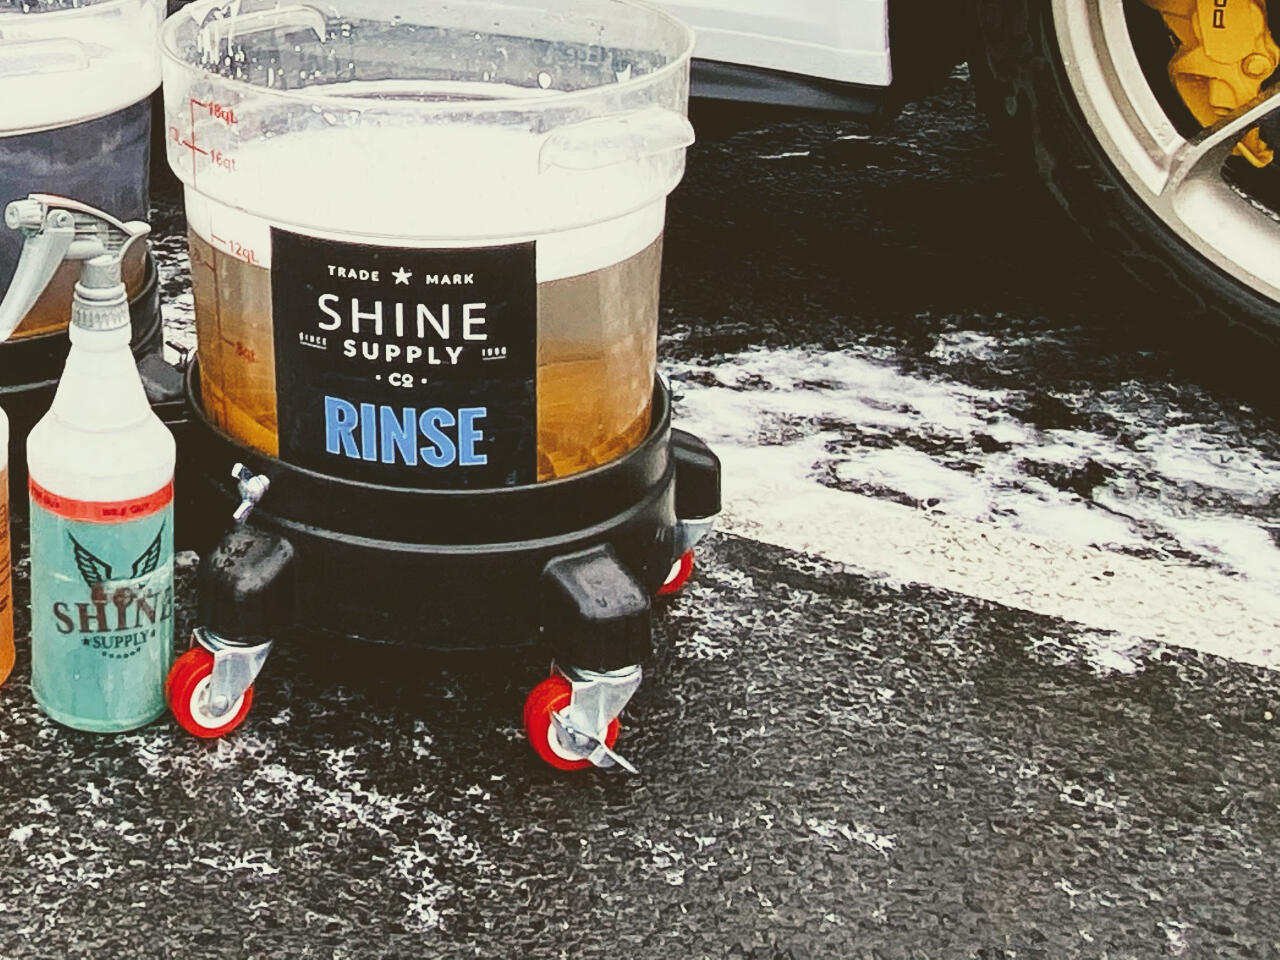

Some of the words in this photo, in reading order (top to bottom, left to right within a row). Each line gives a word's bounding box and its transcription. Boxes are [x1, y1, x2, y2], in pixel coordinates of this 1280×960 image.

[327, 264, 380, 282] TRADE
[425, 273, 475, 285] MARK
[318, 293, 488, 341] SHINE
[343, 339, 464, 365] SUPPLY
[324, 395, 489, 468] RINSE
[94, 630, 150, 650] SUPPLY
